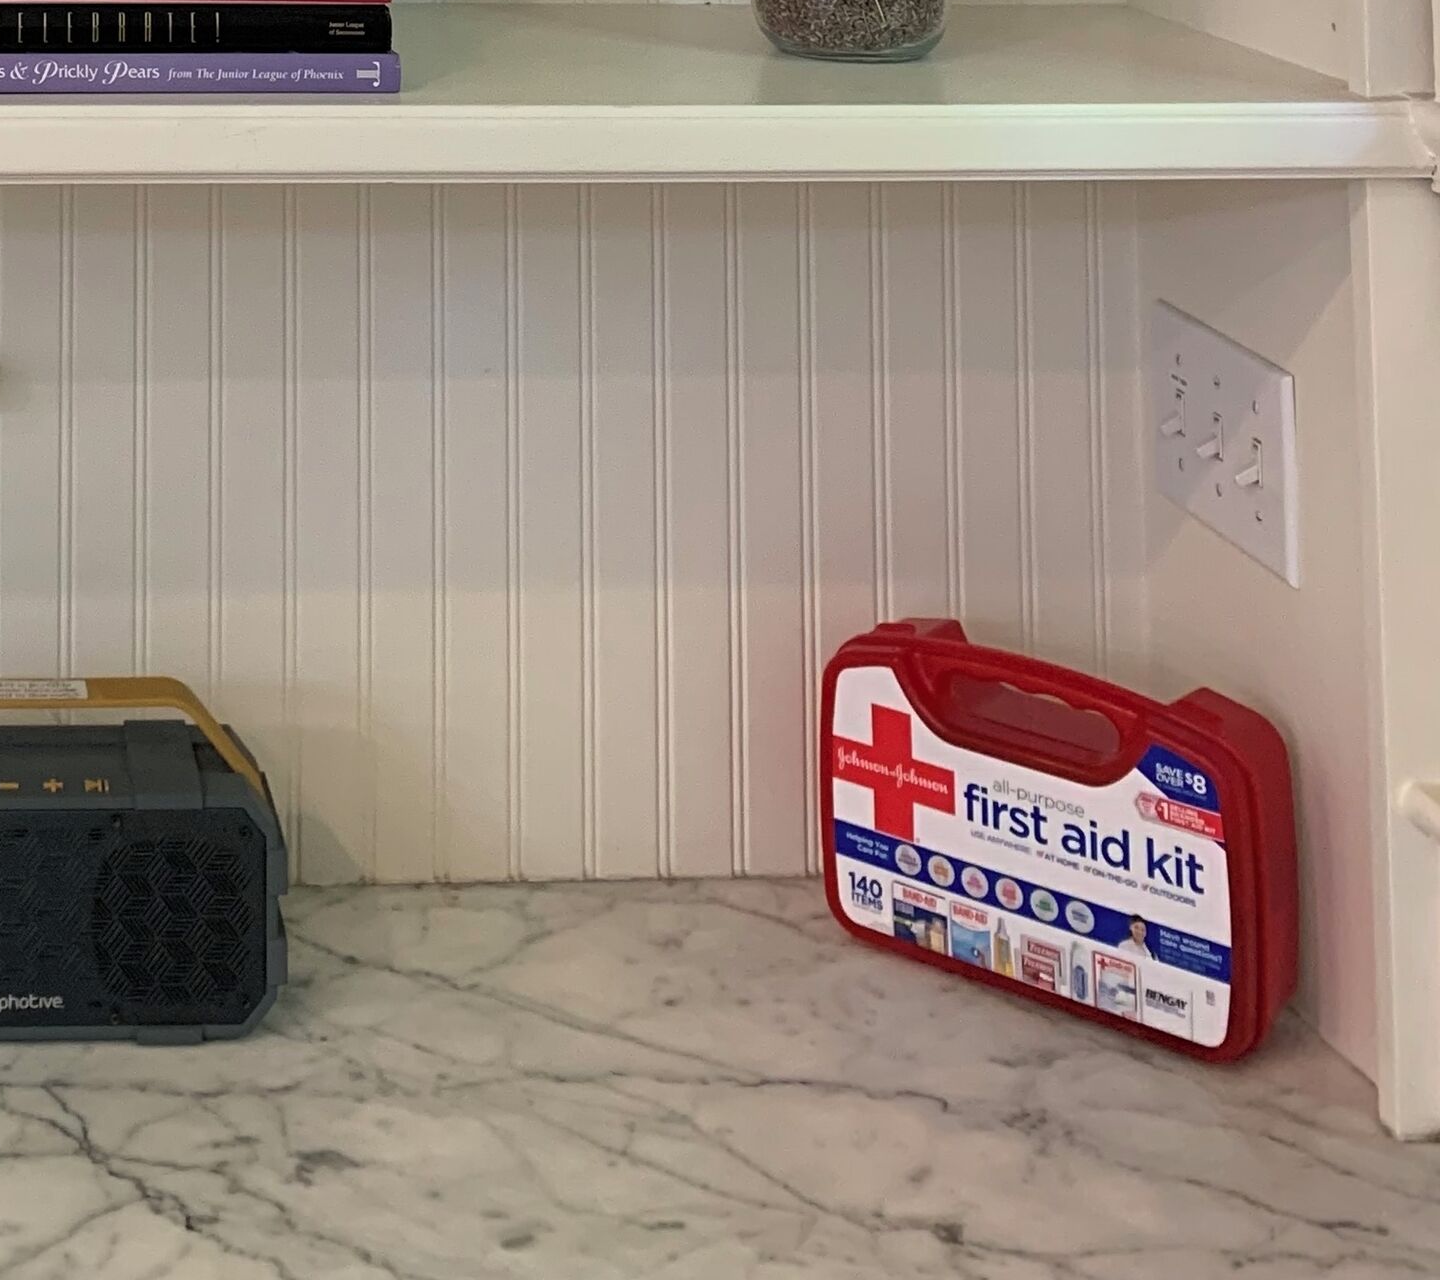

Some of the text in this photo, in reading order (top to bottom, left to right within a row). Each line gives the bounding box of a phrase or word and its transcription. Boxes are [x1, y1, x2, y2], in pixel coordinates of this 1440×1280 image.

[10, 62, 29, 80] &
[32, 60, 99, 86] Prickly
[102, 60, 160, 86] Pears
[167, 67, 193, 82] from
[196, 67, 217, 80] The
[217, 68, 251, 83] Junior
[252, 68, 289, 83] League
[290, 66, 304, 83] of
[304, 68, 344, 81] Phoenix
[1155, 762, 1183, 778] SAVE
[1155, 772, 1184, 788] OVER
[992, 778, 1085, 819] all-purpose
[964, 782, 1206, 895] first aid kit
[848, 871, 883, 899] 140
[851, 891, 884, 911] ITEMS
[1145, 987, 1188, 1011] BENGAY
